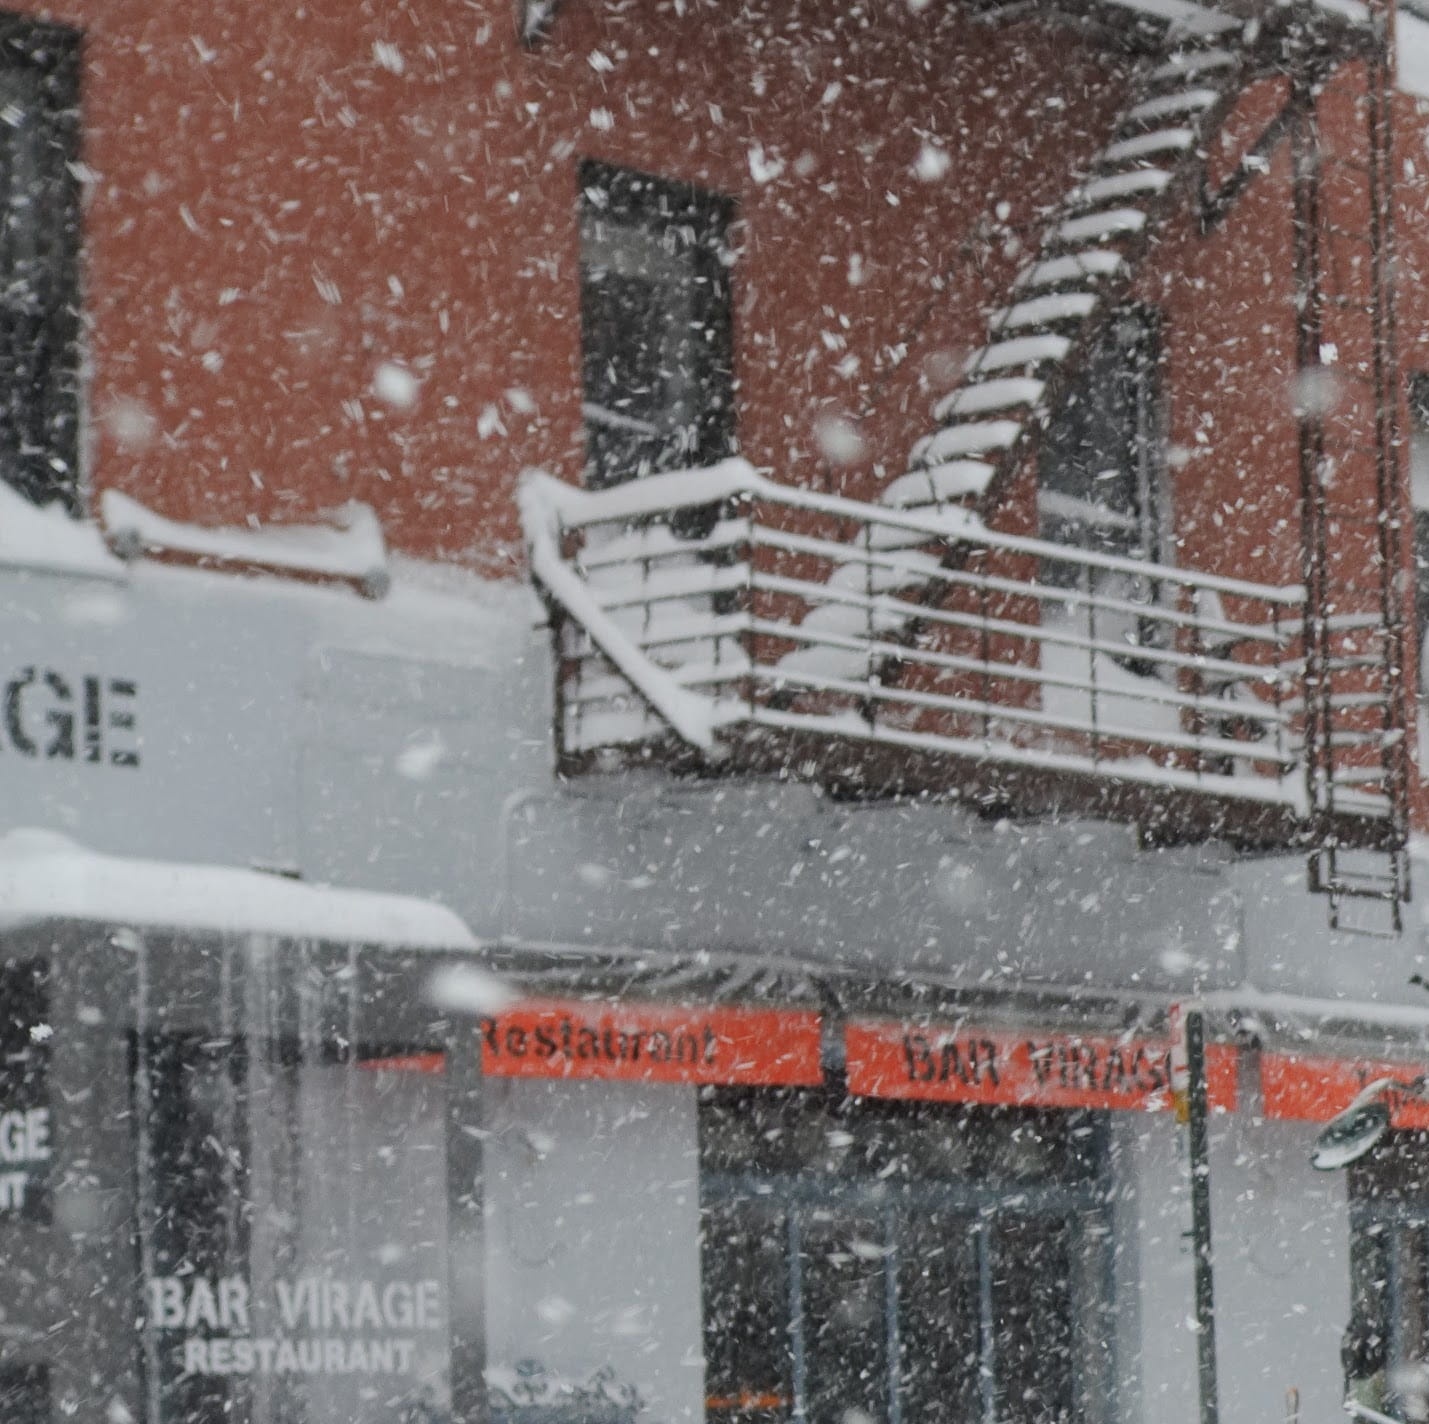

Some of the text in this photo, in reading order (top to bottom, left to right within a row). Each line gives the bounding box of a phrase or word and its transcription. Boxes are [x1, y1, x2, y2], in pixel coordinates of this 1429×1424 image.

[904, 1033, 1172, 1094] BAR VIRAG
[150, 1276, 441, 1330] BAR VIRAGE
[184, 1337, 416, 1375] RESTAURANT
